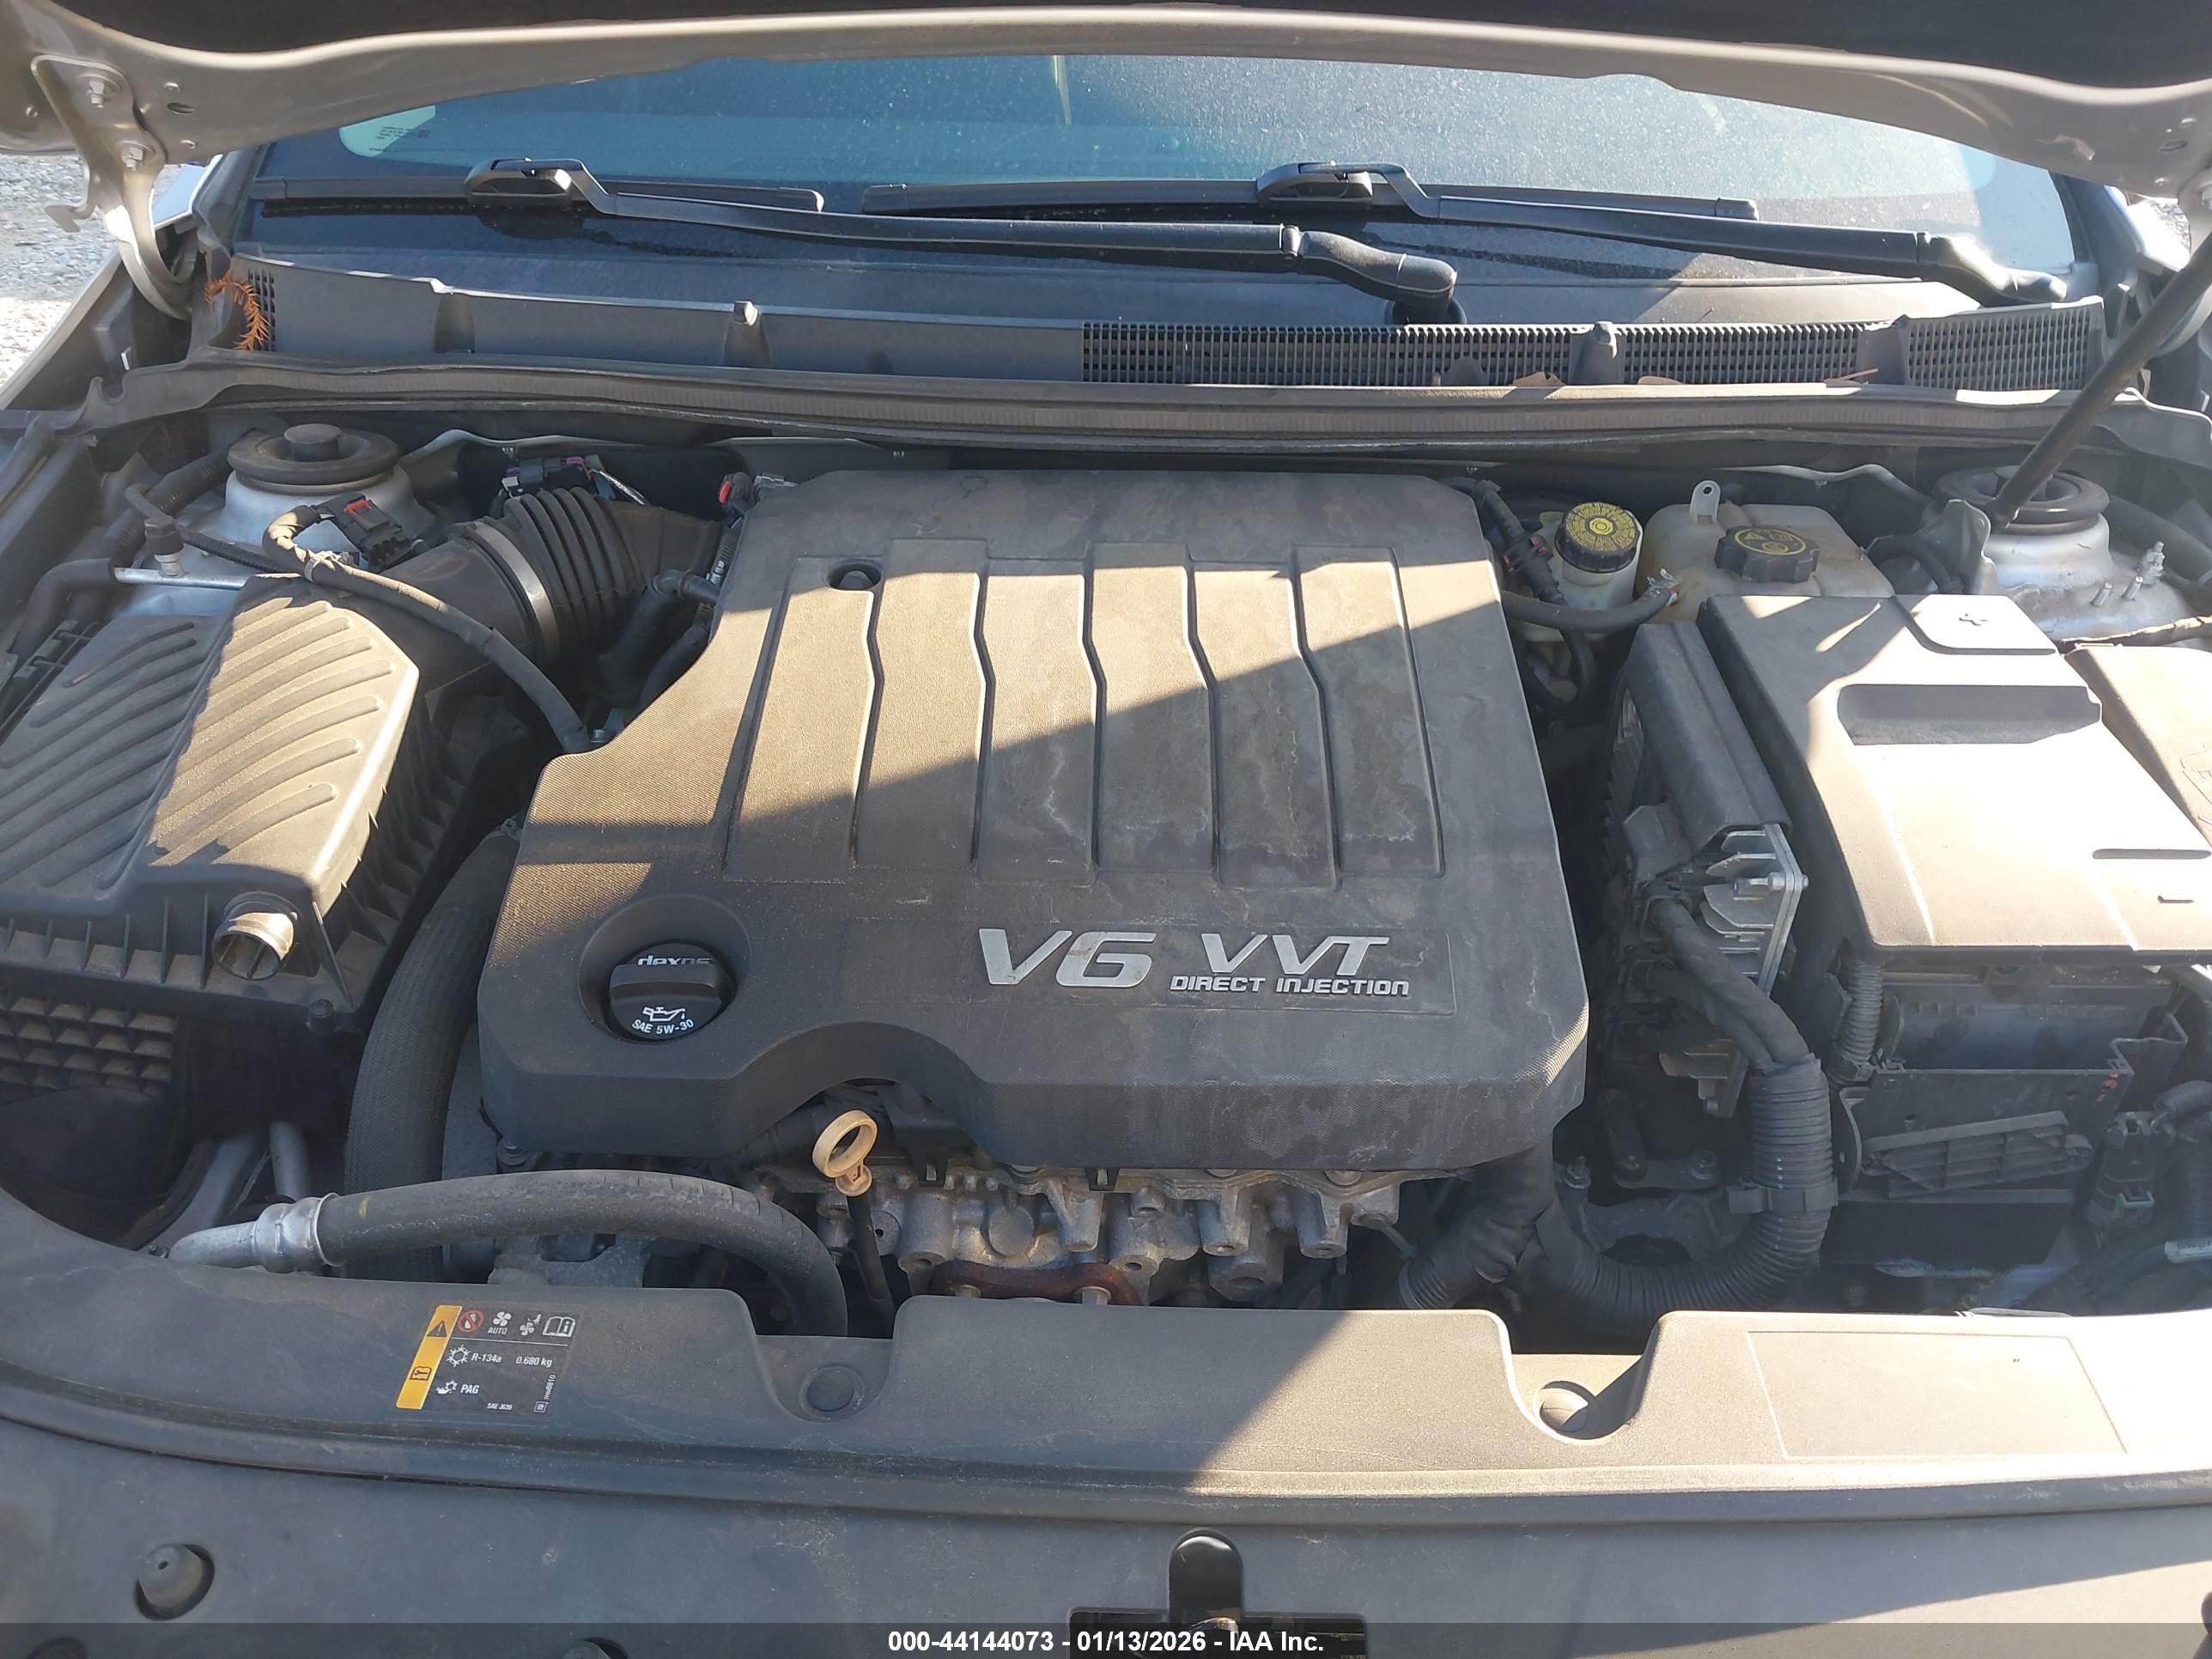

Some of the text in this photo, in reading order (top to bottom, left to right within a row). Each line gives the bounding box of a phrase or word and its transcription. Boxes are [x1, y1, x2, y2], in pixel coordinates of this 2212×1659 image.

[979, 928, 1389, 987] V6 VVT
[1170, 975, 1409, 996] DIRECT INJECTION
[632, 1018, 694, 1035] SAE 5W-30
[488, 1327, 507, 1335] AUTO
[471, 1352, 552, 1368] R-134a 0.680 kg
[460, 1384, 480, 1395] PAG
